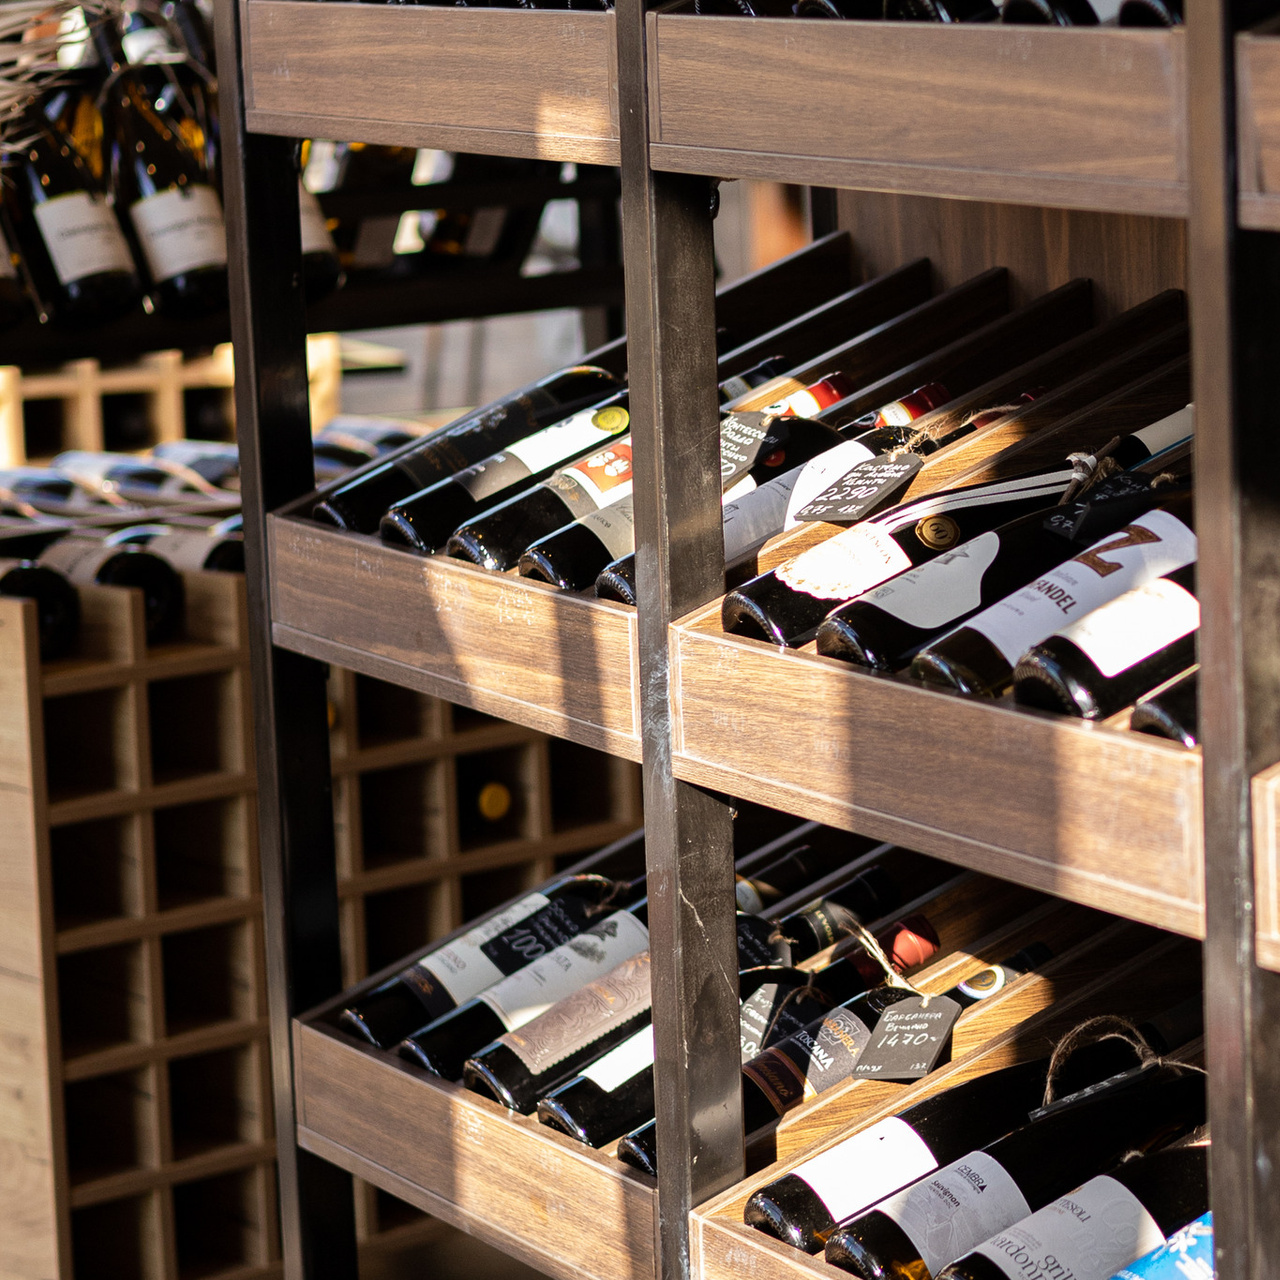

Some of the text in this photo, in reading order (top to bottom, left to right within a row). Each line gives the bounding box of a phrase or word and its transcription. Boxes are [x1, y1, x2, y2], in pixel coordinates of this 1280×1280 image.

[814, 486, 879, 502] 2290
[796, 1030, 835, 1070] TOSCANA
[930, 1179, 962, 1209] Sauvignon
